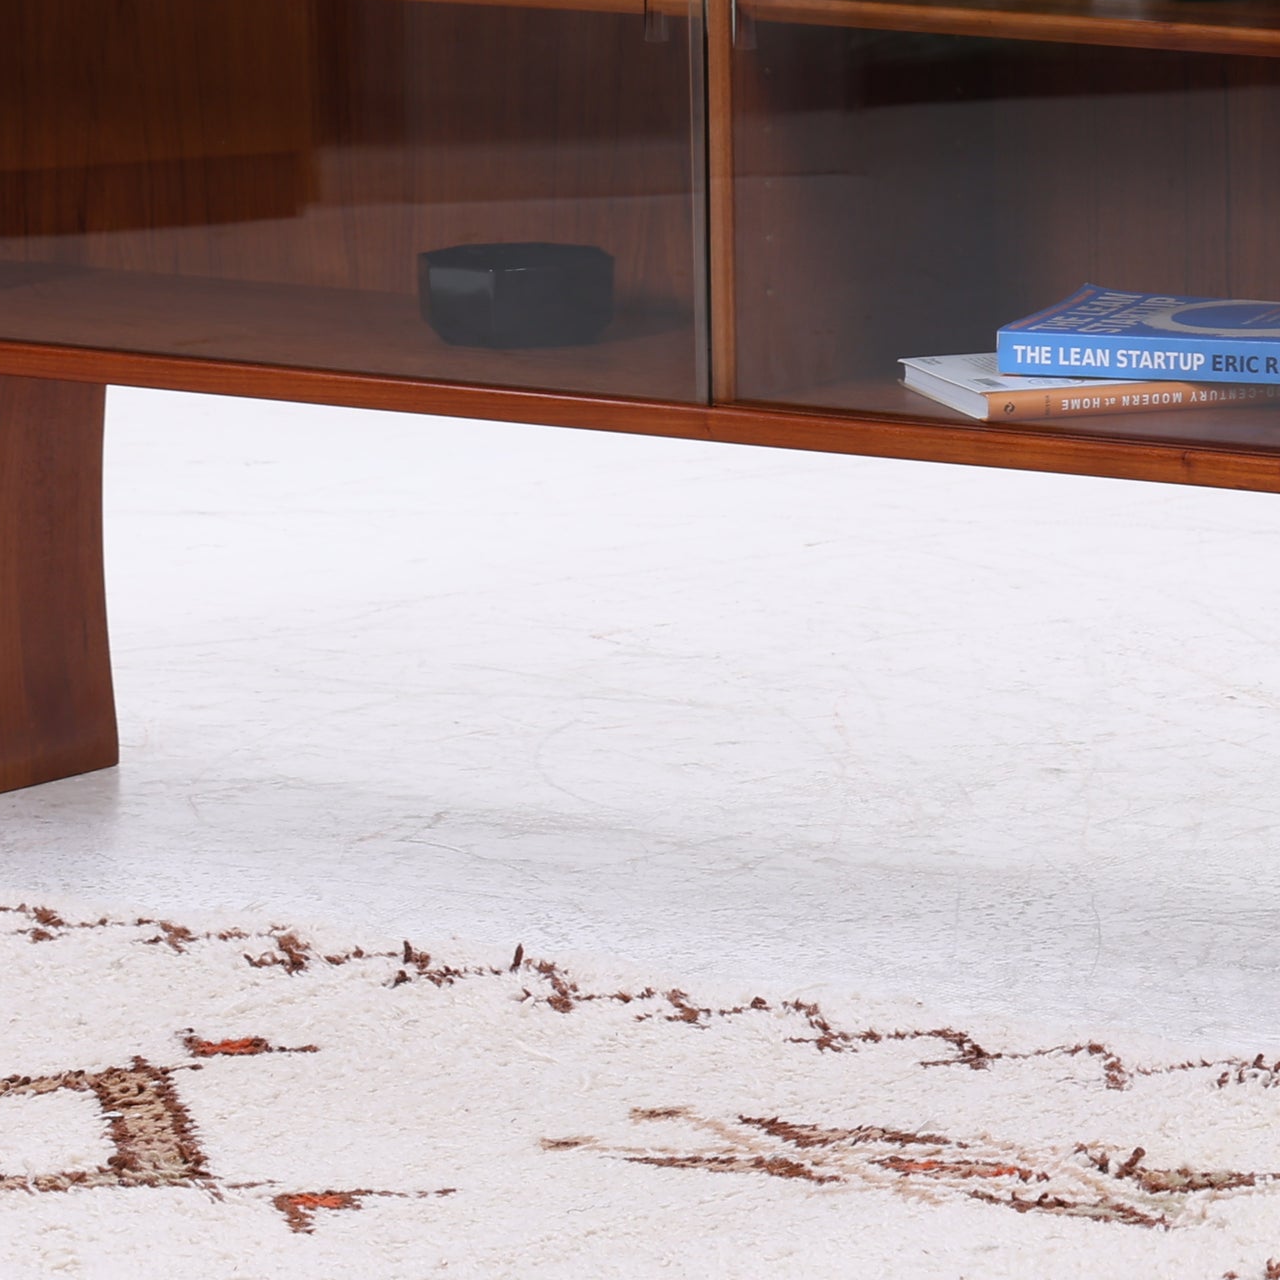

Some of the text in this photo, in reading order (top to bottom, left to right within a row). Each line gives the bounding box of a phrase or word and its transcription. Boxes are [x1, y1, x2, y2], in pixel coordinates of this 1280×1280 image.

[1027, 292, 1143, 331] THE LEAN
[1013, 345, 1052, 365] THE
[1058, 346, 1110, 367] LEAN
[1116, 349, 1205, 371] STARTUP
[1211, 354, 1259, 374] ERIC
[1061, 396, 1101, 411] HOME
[1105, 397, 1116, 406] at
[1122, 391, 1183, 407] MODERN
